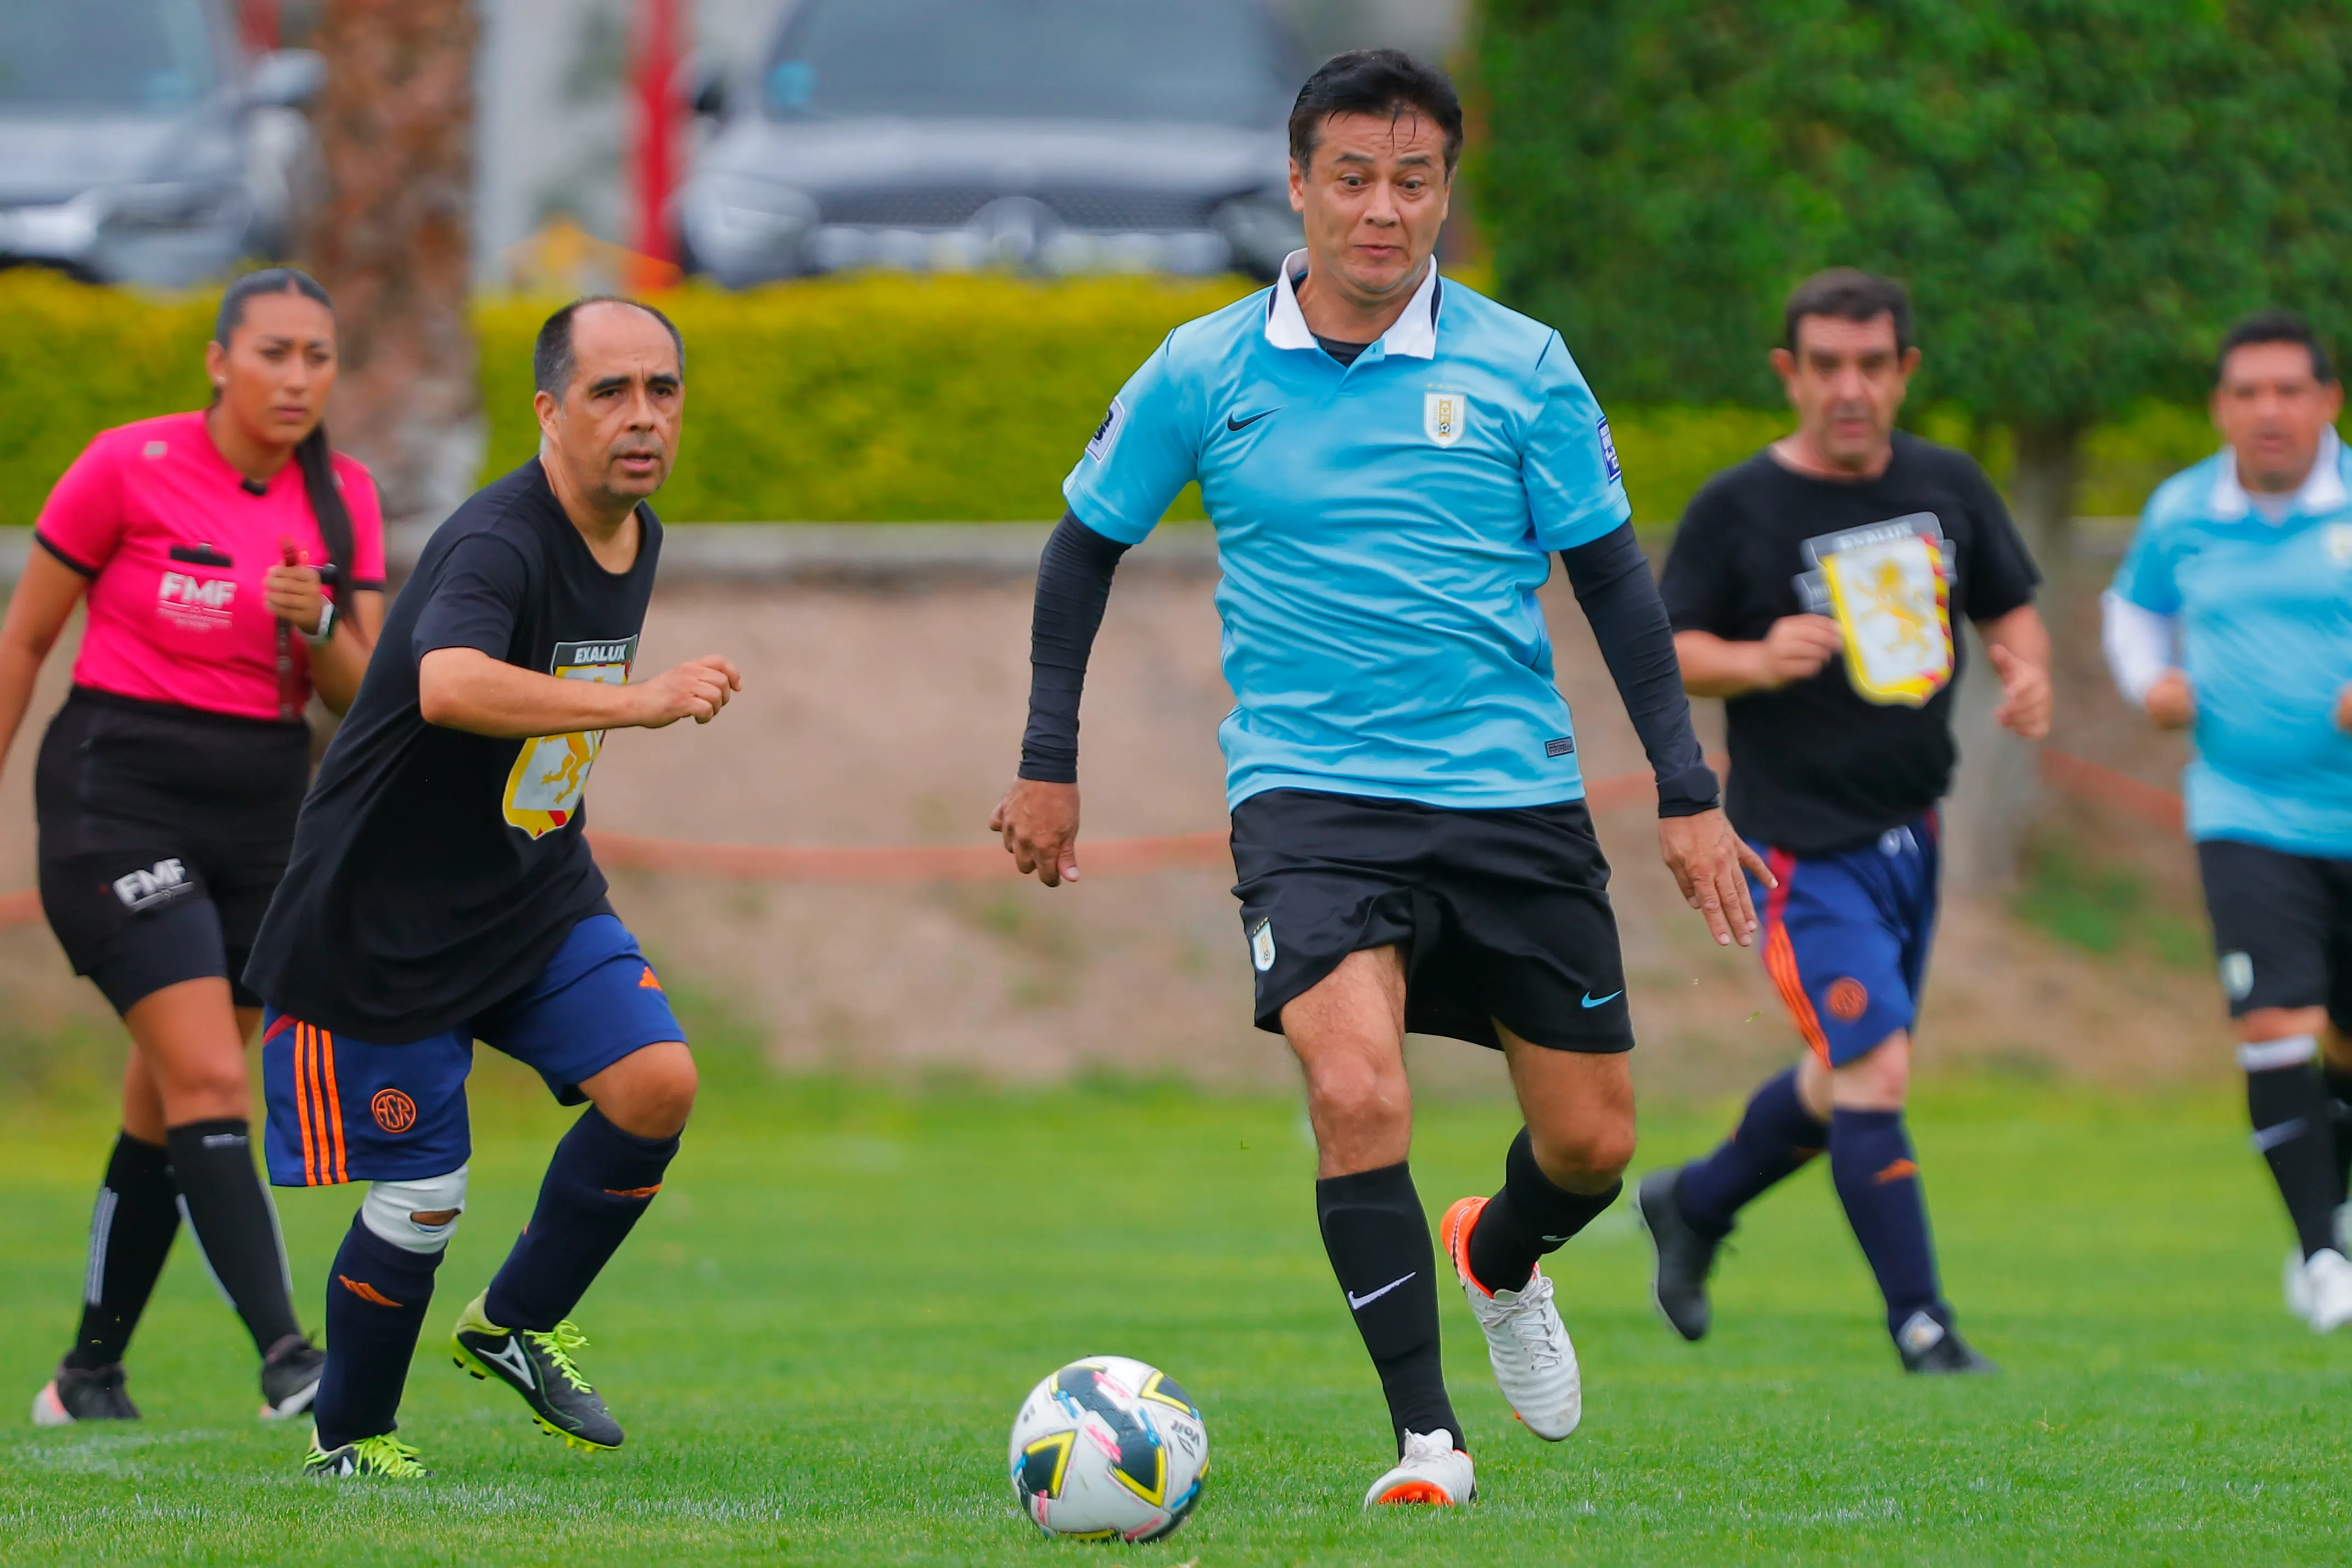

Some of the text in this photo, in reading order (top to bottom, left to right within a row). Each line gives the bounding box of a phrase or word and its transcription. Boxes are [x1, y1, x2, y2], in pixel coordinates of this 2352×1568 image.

[158, 570, 237, 607] FMF
[573, 643, 628, 664] EXALUX
[113, 858, 186, 906] FMF
[376, 1094, 411, 1128] ASR
